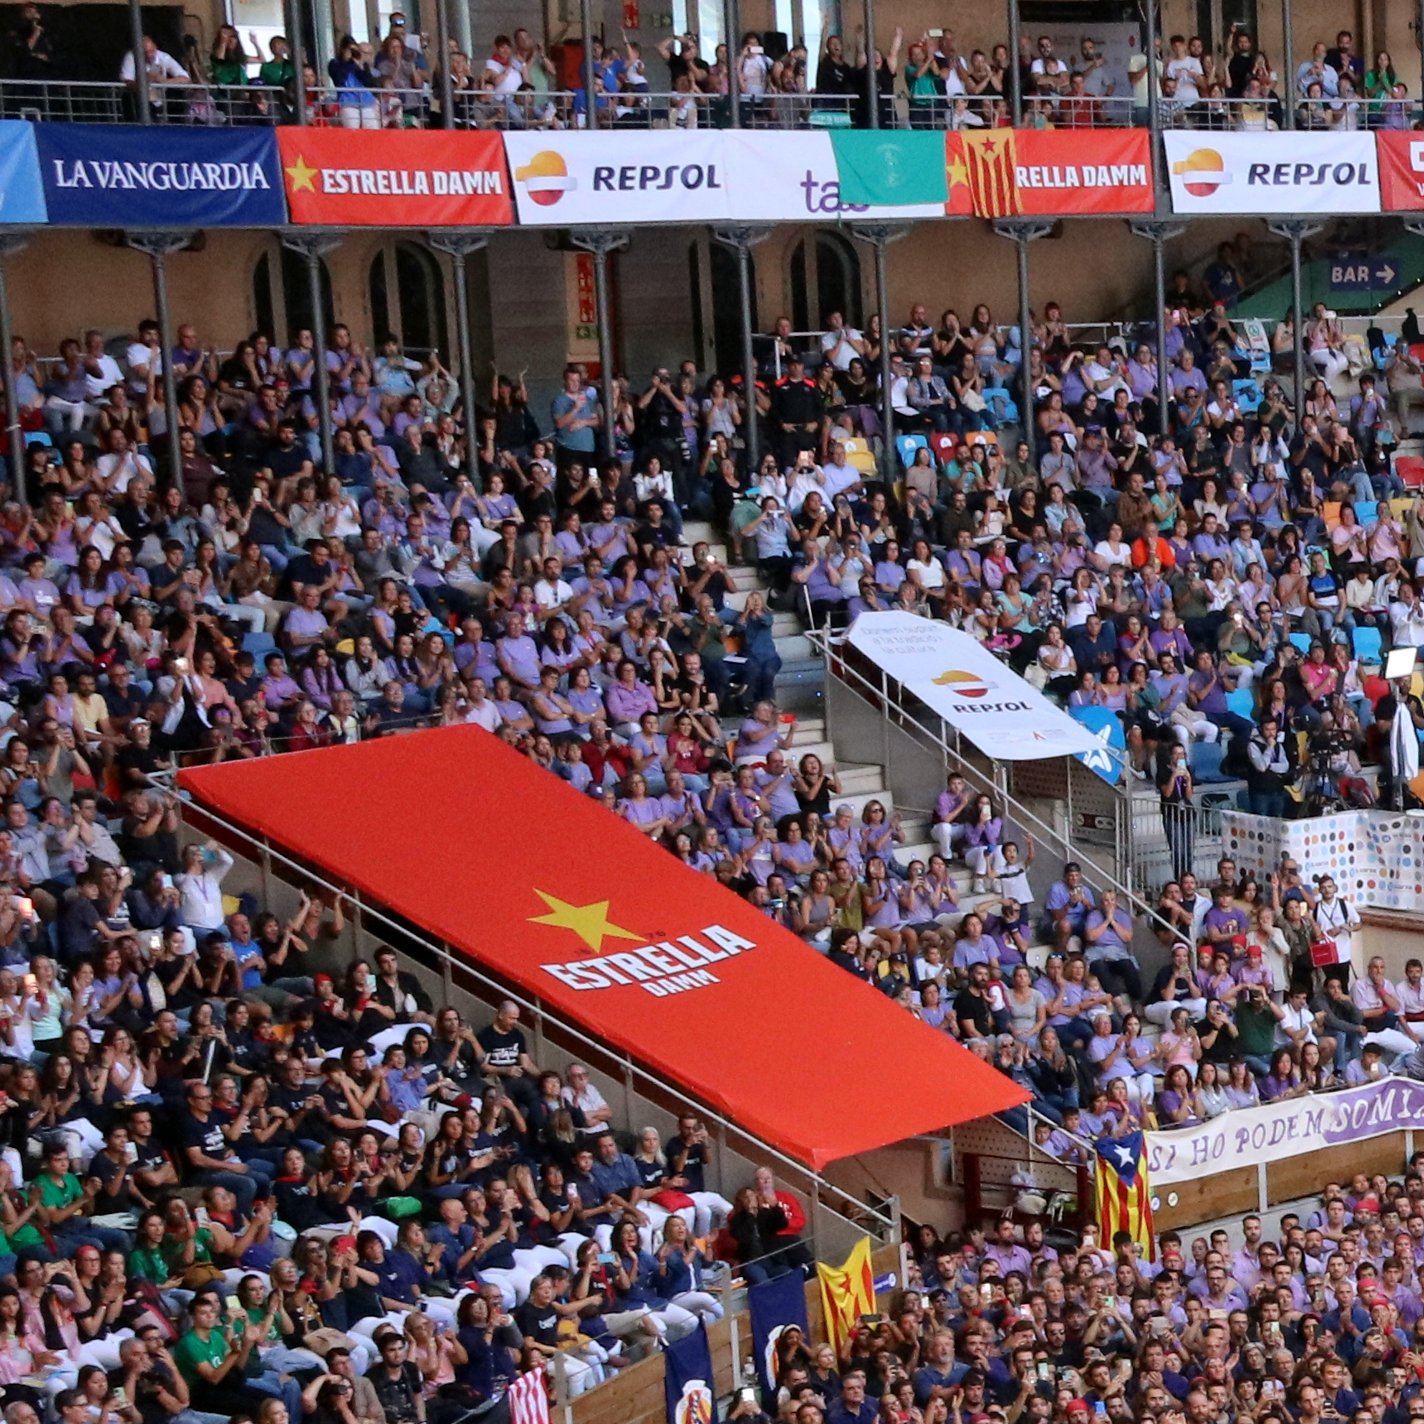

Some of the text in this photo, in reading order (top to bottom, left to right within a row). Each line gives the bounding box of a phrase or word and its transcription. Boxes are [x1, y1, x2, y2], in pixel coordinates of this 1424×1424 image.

[53, 159, 271, 190] LA VANGUARDIA
[321, 168, 503, 195] ESTRELLA DAMM
[592, 164, 721, 191] REPSOL
[1015, 164, 1147, 188] RELLA DAMM
[1247, 162, 1372, 186] REPSOL
[1331, 265, 1370, 283] BAR
[952, 700, 1033, 714] REPSOL
[539, 924, 758, 991] ESTRELLA
[640, 969, 721, 998] DAMM
[1148, 1144, 1177, 1173] SI
[1190, 1132, 1226, 1167] HO
[1235, 1108, 1325, 1154] PODEM
